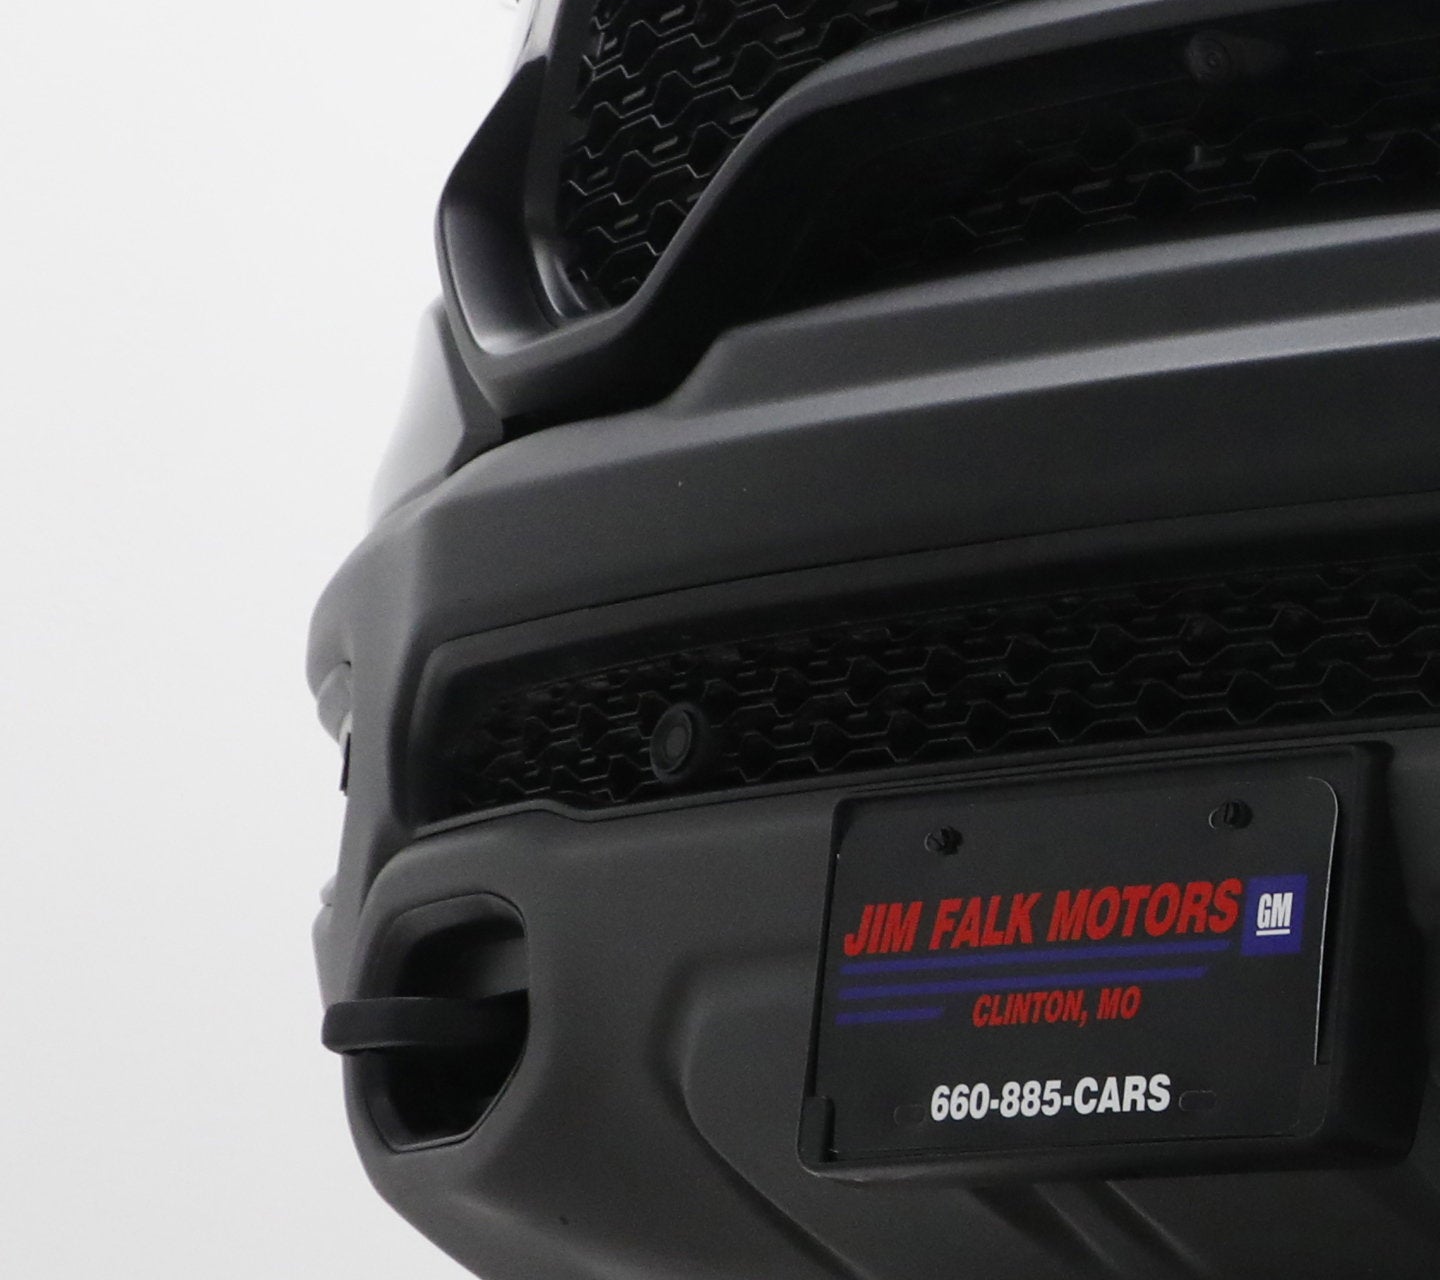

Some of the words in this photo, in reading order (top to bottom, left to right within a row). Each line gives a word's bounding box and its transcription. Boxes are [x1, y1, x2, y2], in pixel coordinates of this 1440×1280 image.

[843, 900, 924, 958] JIM
[929, 892, 1043, 952] FALK
[1047, 877, 1243, 944] MOTORS
[1256, 892, 1295, 931] GM
[972, 990, 1090, 1029] CLINTON,
[1097, 985, 1144, 1021] MO
[930, 1073, 1172, 1123] 660-885-CARS
